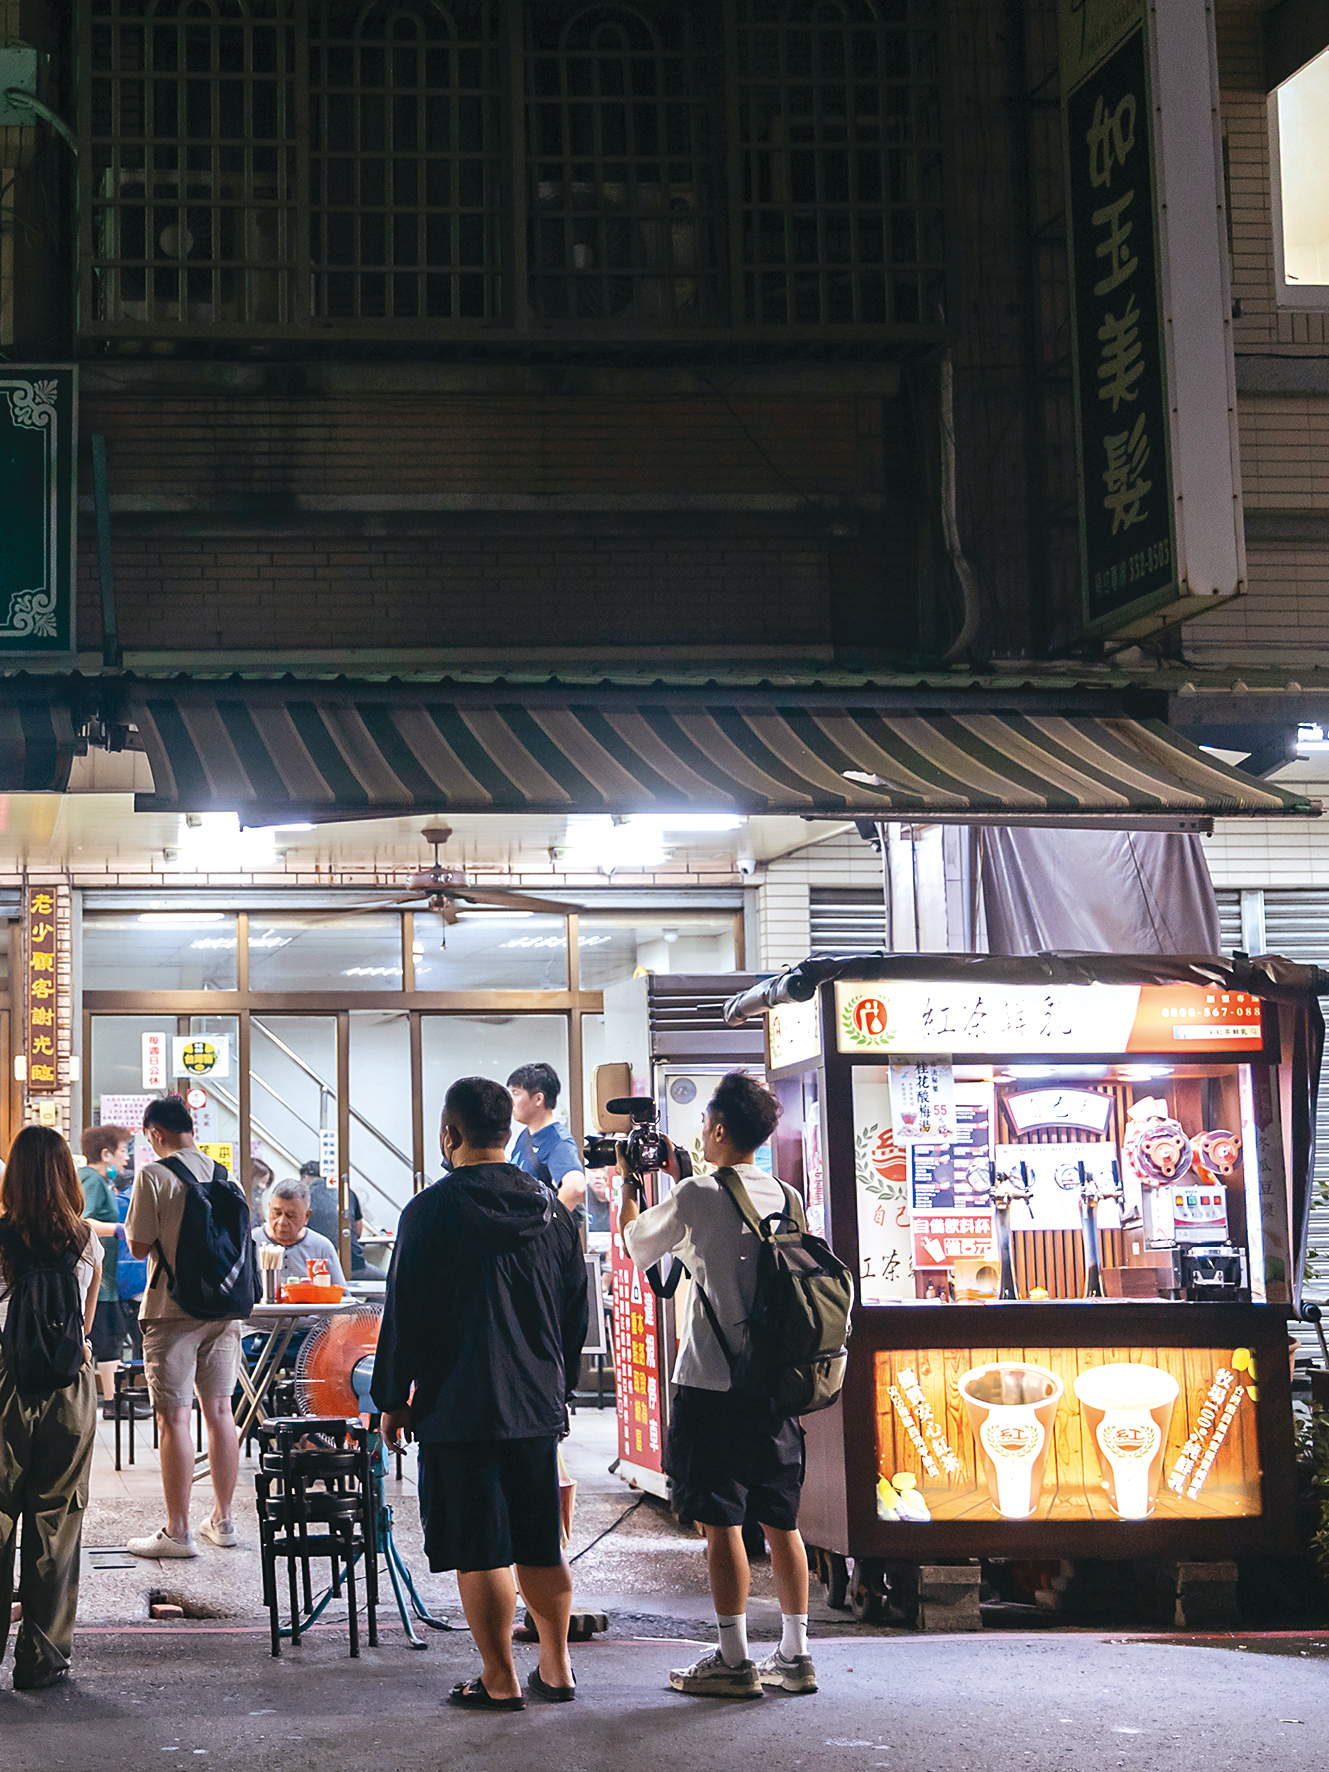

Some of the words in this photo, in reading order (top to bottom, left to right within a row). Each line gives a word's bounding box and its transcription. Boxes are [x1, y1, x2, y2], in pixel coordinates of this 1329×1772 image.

[1086, 94, 1152, 536] 如玉美髮
[29, 893, 54, 1082] 老少顧客謝光臨
[1161, 1007, 1261, 1018] 0800-567-088
[934, 1104, 947, 1116] 55
[643, 1270, 660, 1453] 違規停車
